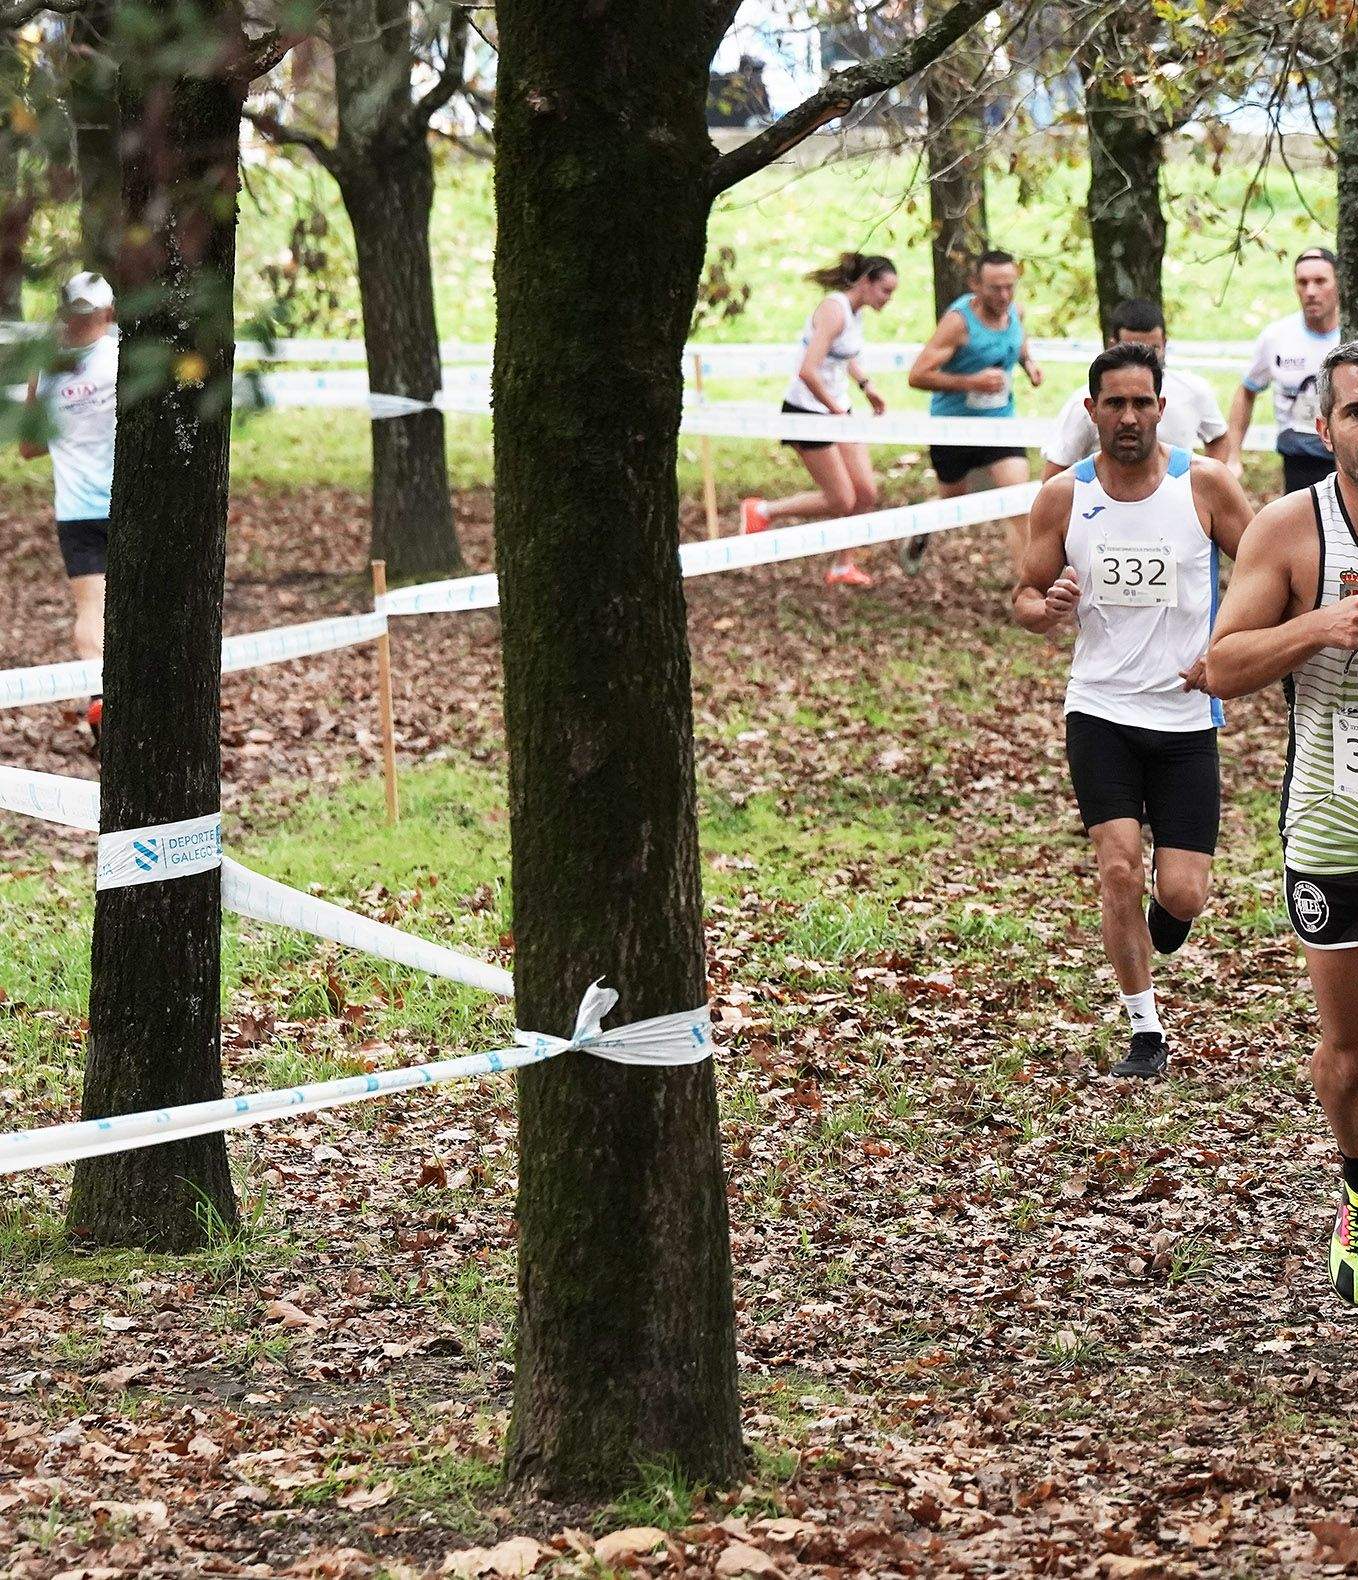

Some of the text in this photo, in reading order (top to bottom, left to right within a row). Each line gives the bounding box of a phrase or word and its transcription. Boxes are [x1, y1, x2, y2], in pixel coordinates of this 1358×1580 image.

[1103, 558, 1166, 586] 332
[169, 829, 214, 849] DEPORTE
[171, 845, 213, 864] GALEGO
